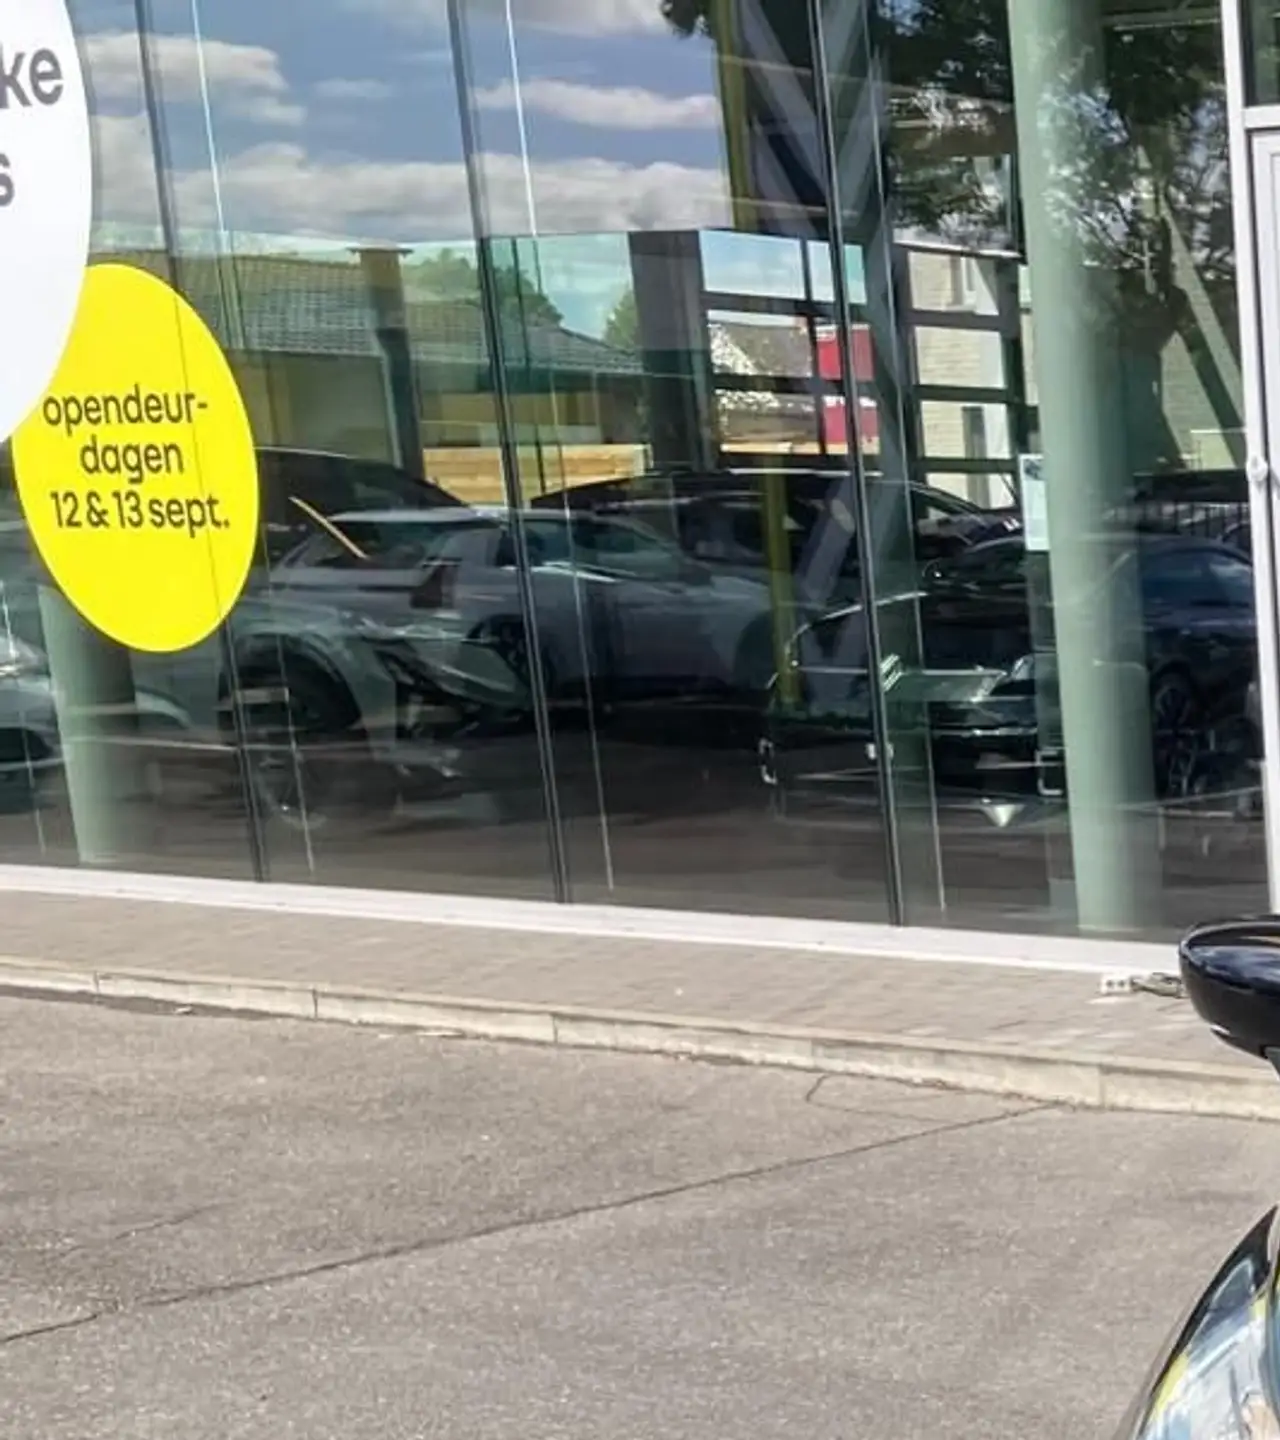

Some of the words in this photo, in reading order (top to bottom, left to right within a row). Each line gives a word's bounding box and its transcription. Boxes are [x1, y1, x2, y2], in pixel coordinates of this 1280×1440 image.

[43, 382, 208, 437] opendeur-
[80, 433, 185, 485] dagen
[50, 491, 82, 528] 12
[86, 491, 109, 528] &
[112, 490, 144, 529] 13
[149, 494, 230, 539] sept.
